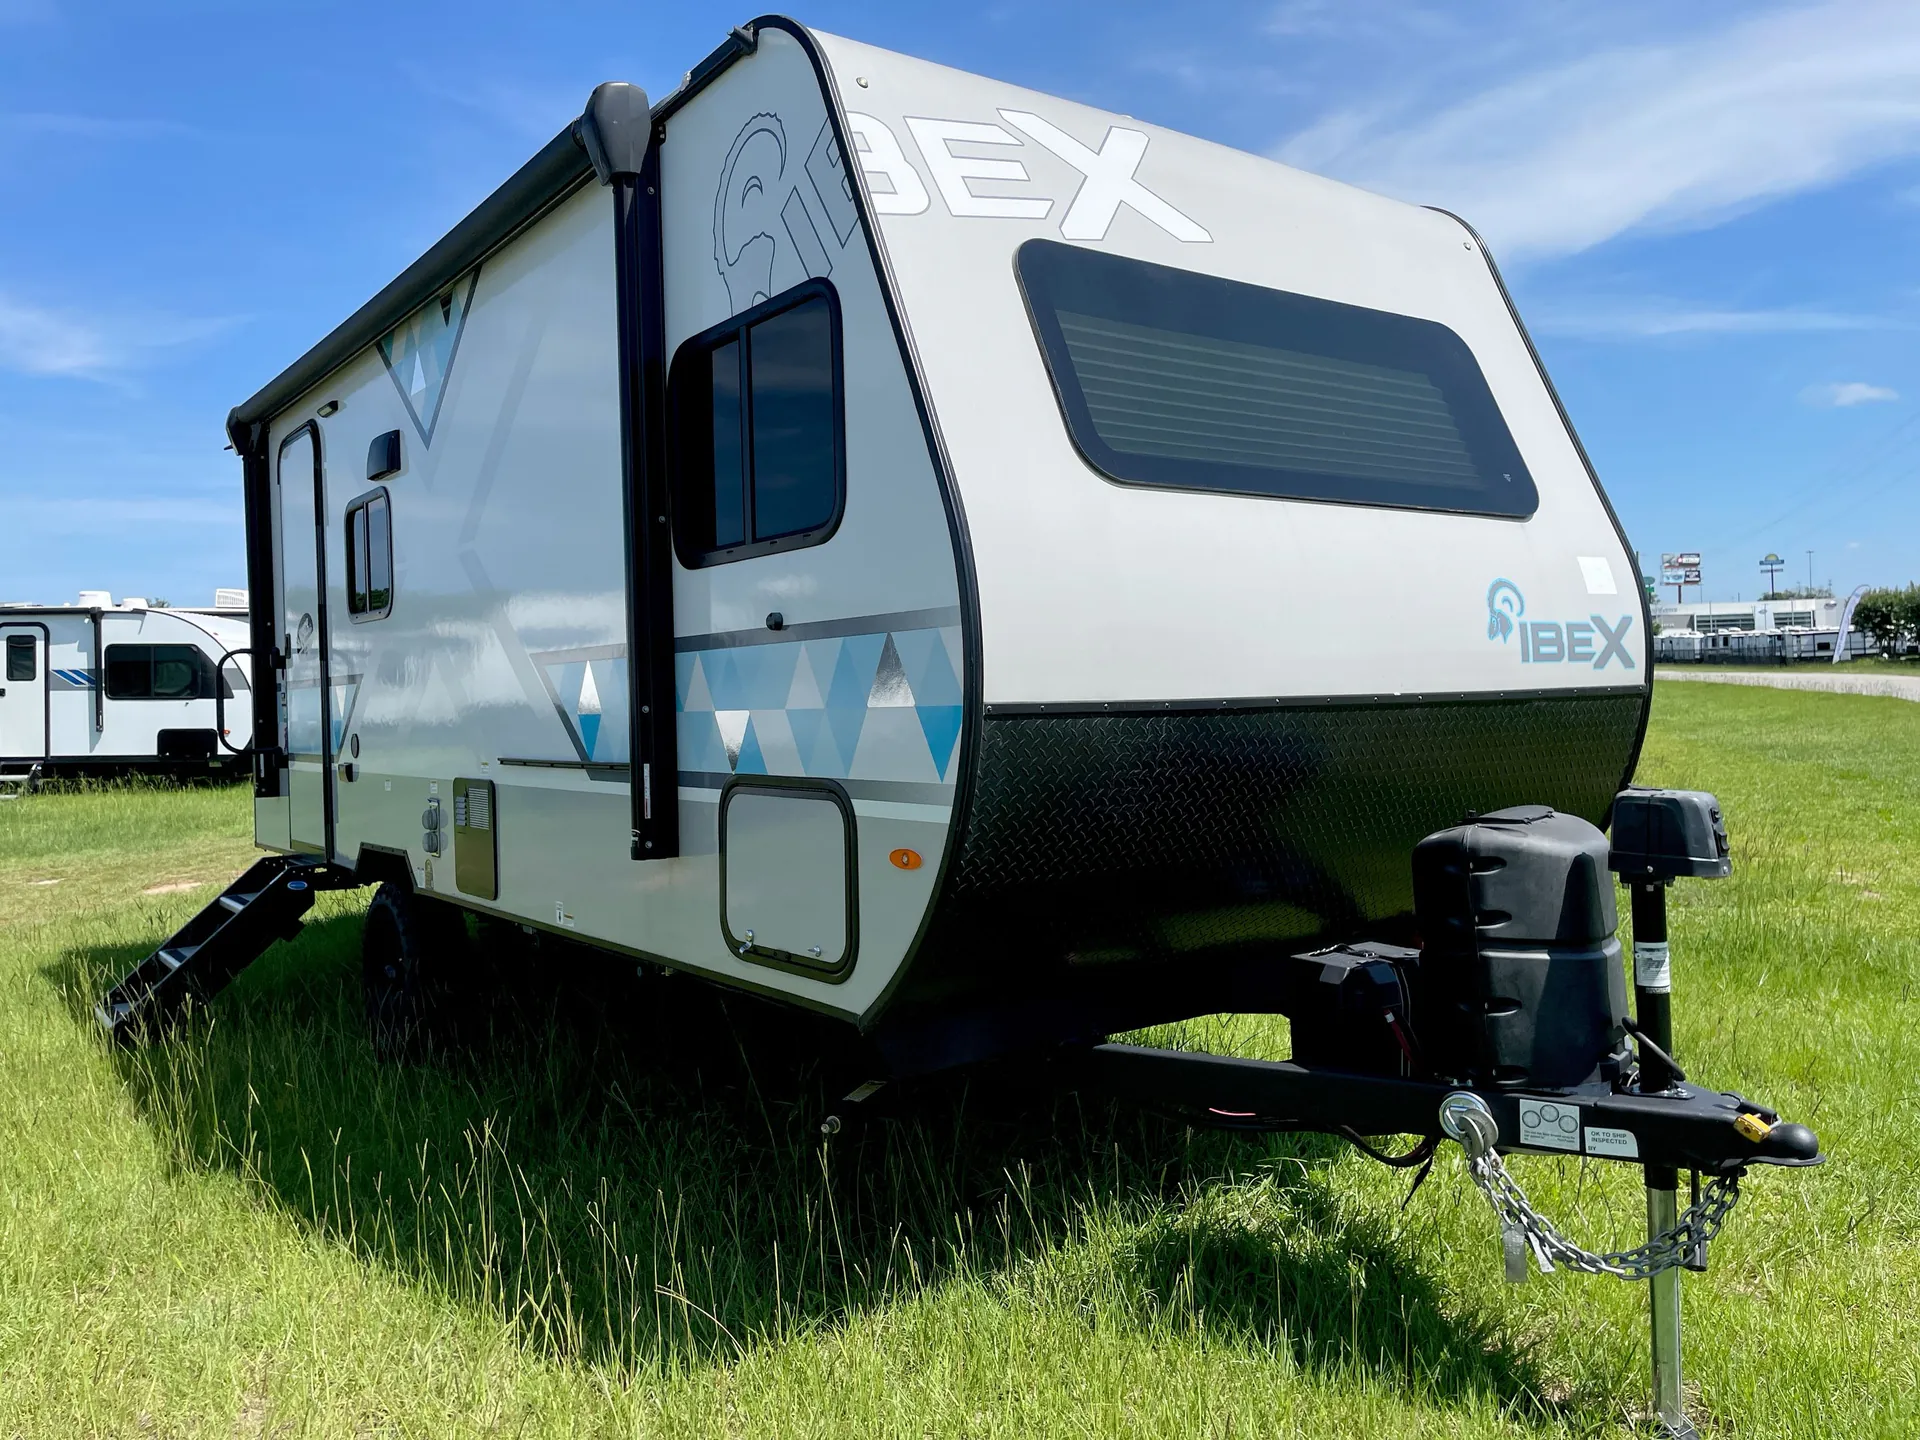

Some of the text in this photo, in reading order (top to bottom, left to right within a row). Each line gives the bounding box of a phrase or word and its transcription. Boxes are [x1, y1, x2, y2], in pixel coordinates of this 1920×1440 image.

[781, 107, 1214, 279] IBEX
[1518, 614, 1636, 670] IBEX
[1591, 1137, 1628, 1145] INSPECTED
